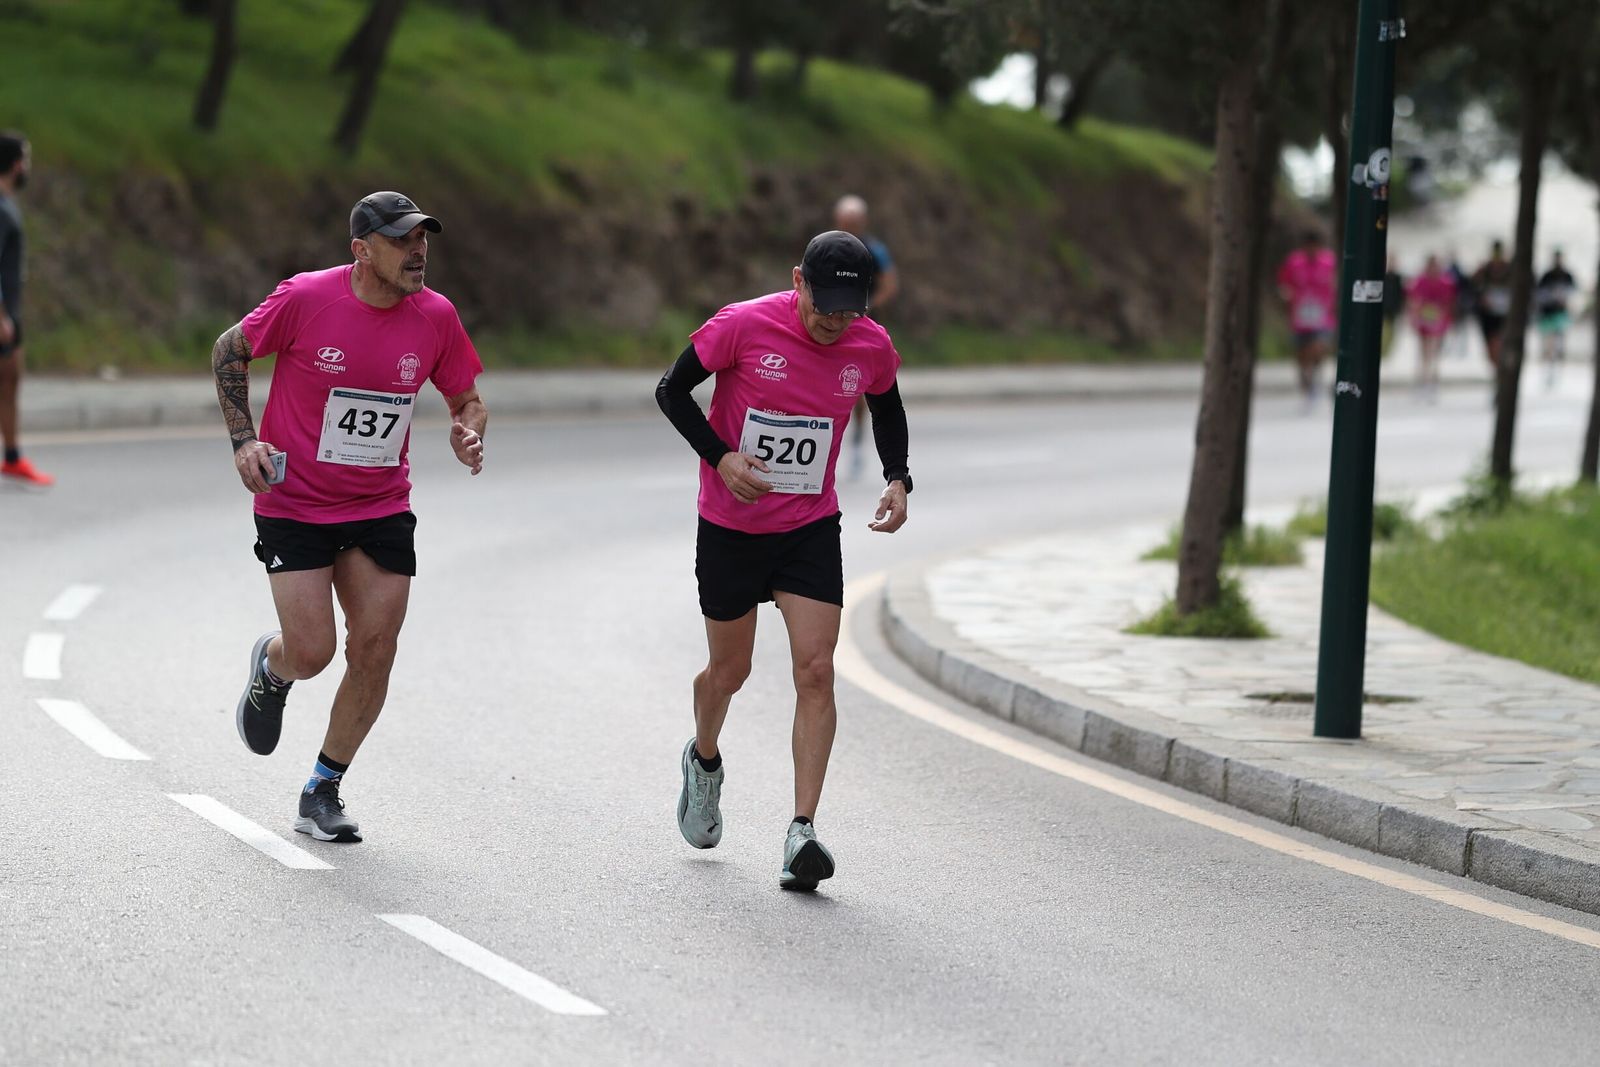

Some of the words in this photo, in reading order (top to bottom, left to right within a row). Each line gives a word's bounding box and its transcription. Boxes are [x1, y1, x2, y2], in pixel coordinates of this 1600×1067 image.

[836, 270, 858, 278] KIPRUN
[314, 360, 346, 372] HYUNDAI
[754, 367, 788, 379] HYUNDAI
[337, 408, 400, 440] 437
[754, 434, 817, 466] 520
